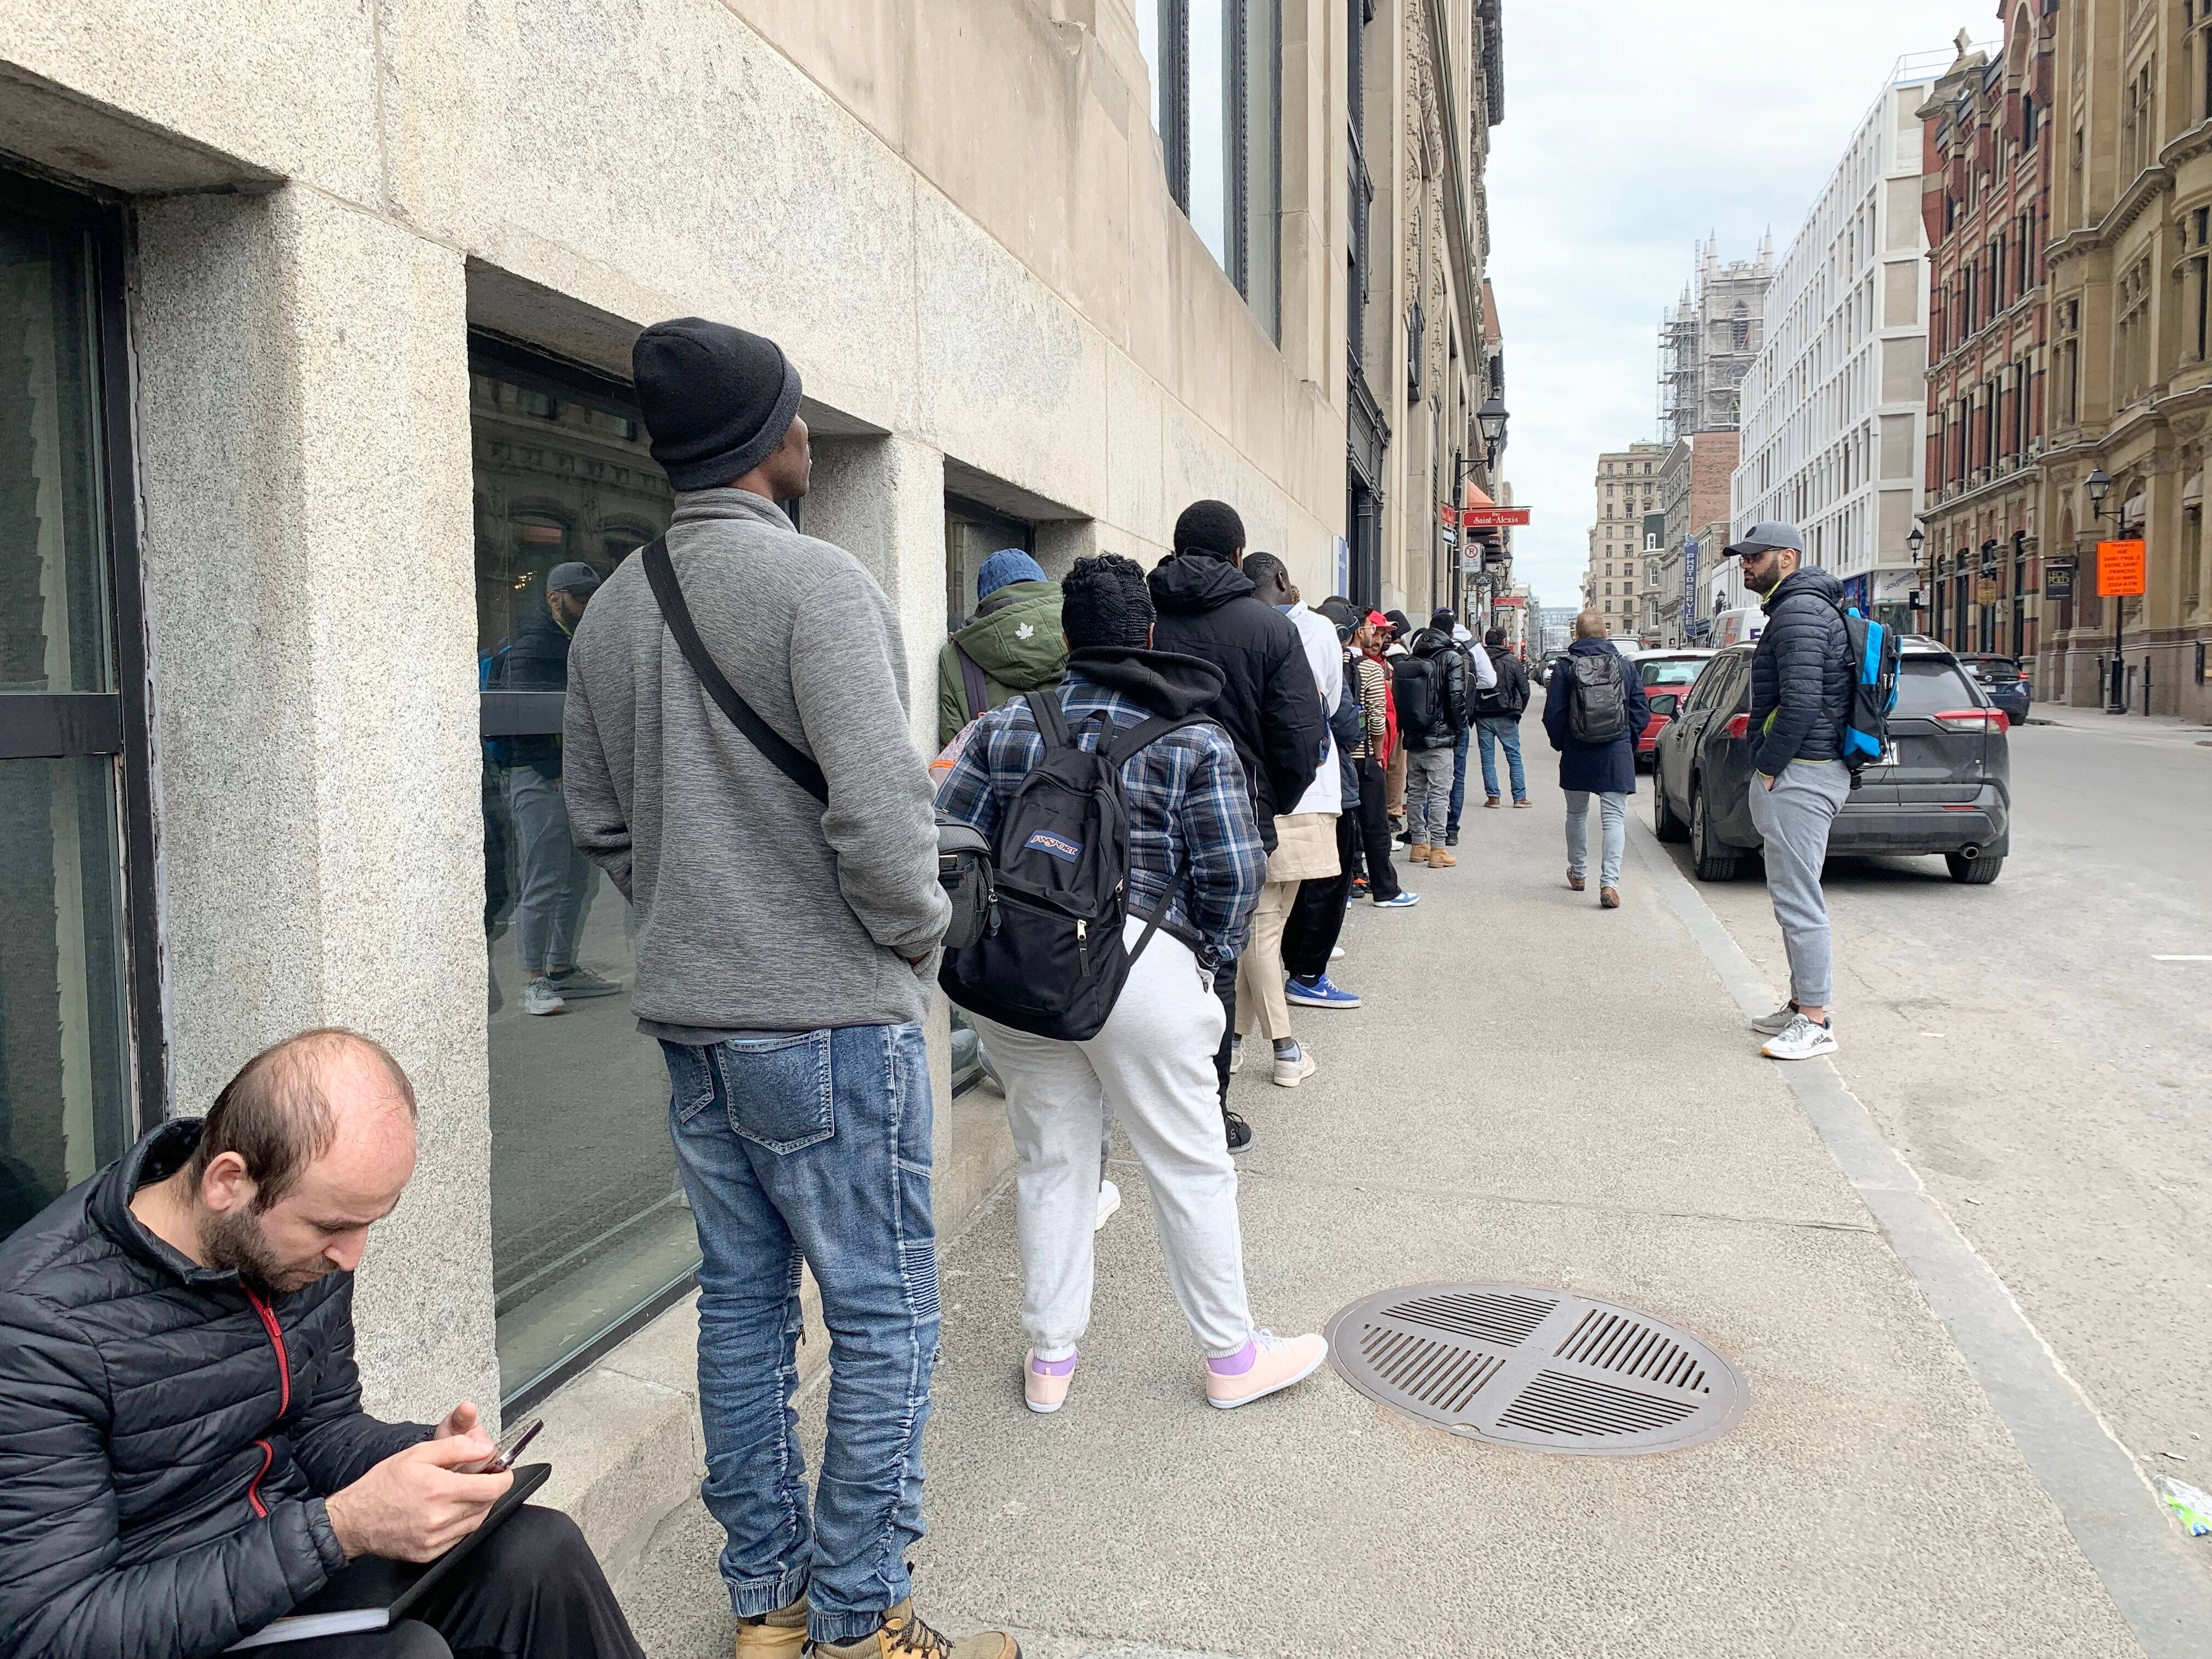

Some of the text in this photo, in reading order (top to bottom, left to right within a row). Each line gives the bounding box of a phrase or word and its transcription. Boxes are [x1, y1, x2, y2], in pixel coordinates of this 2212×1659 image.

[1686, 553, 1695, 583] PHOTO
[1685, 585, 1694, 625] SERVICE
[1030, 835, 1078, 855] JANSPORT
[1811, 1034, 1824, 1048] HOKA
